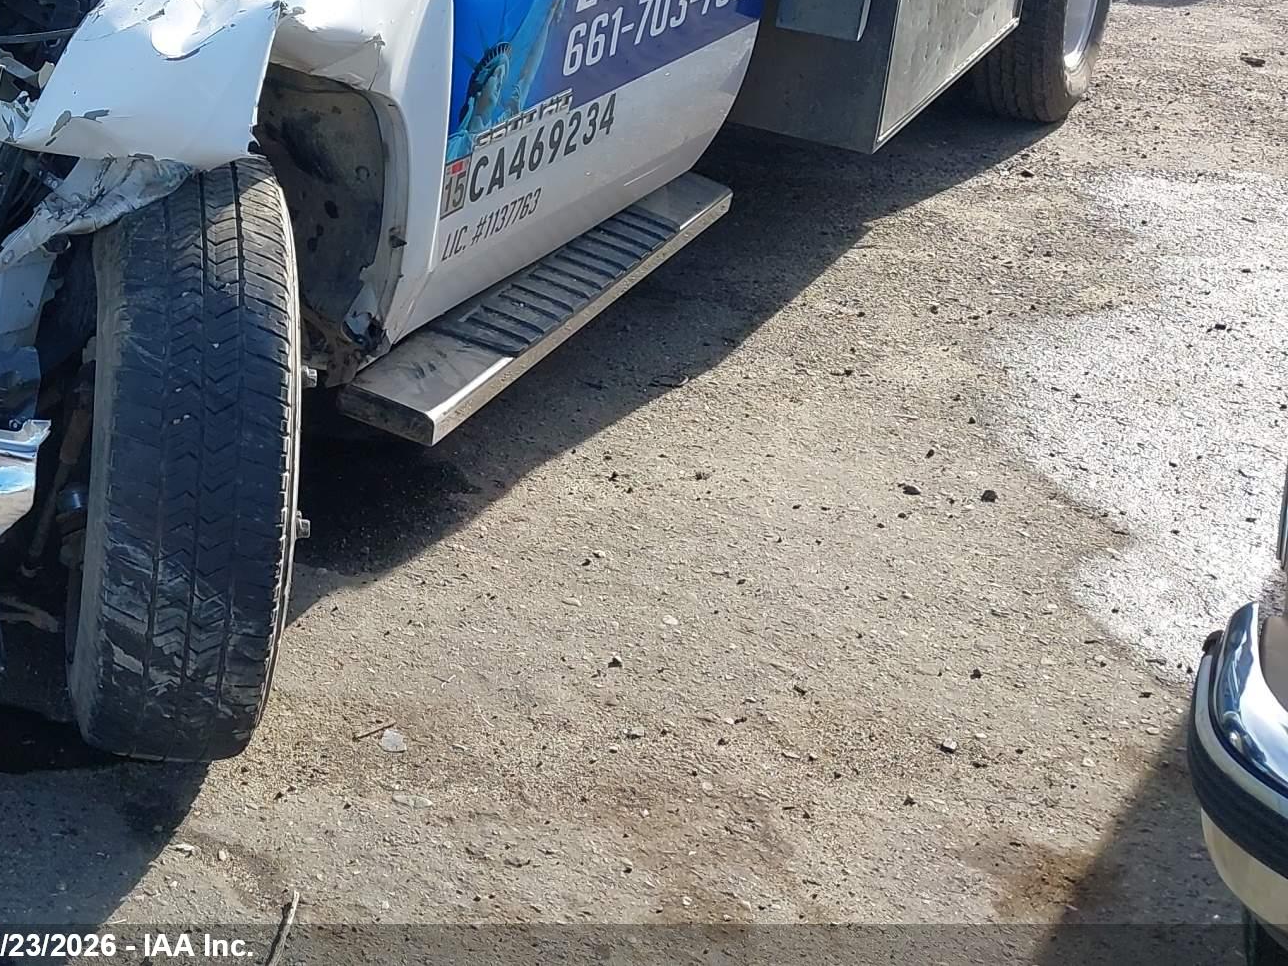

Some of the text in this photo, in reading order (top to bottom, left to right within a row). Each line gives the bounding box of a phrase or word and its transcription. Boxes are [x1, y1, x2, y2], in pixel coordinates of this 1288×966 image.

[468, 93, 617, 203] CA469234
[441, 188, 542, 262] LIC. #1137763
